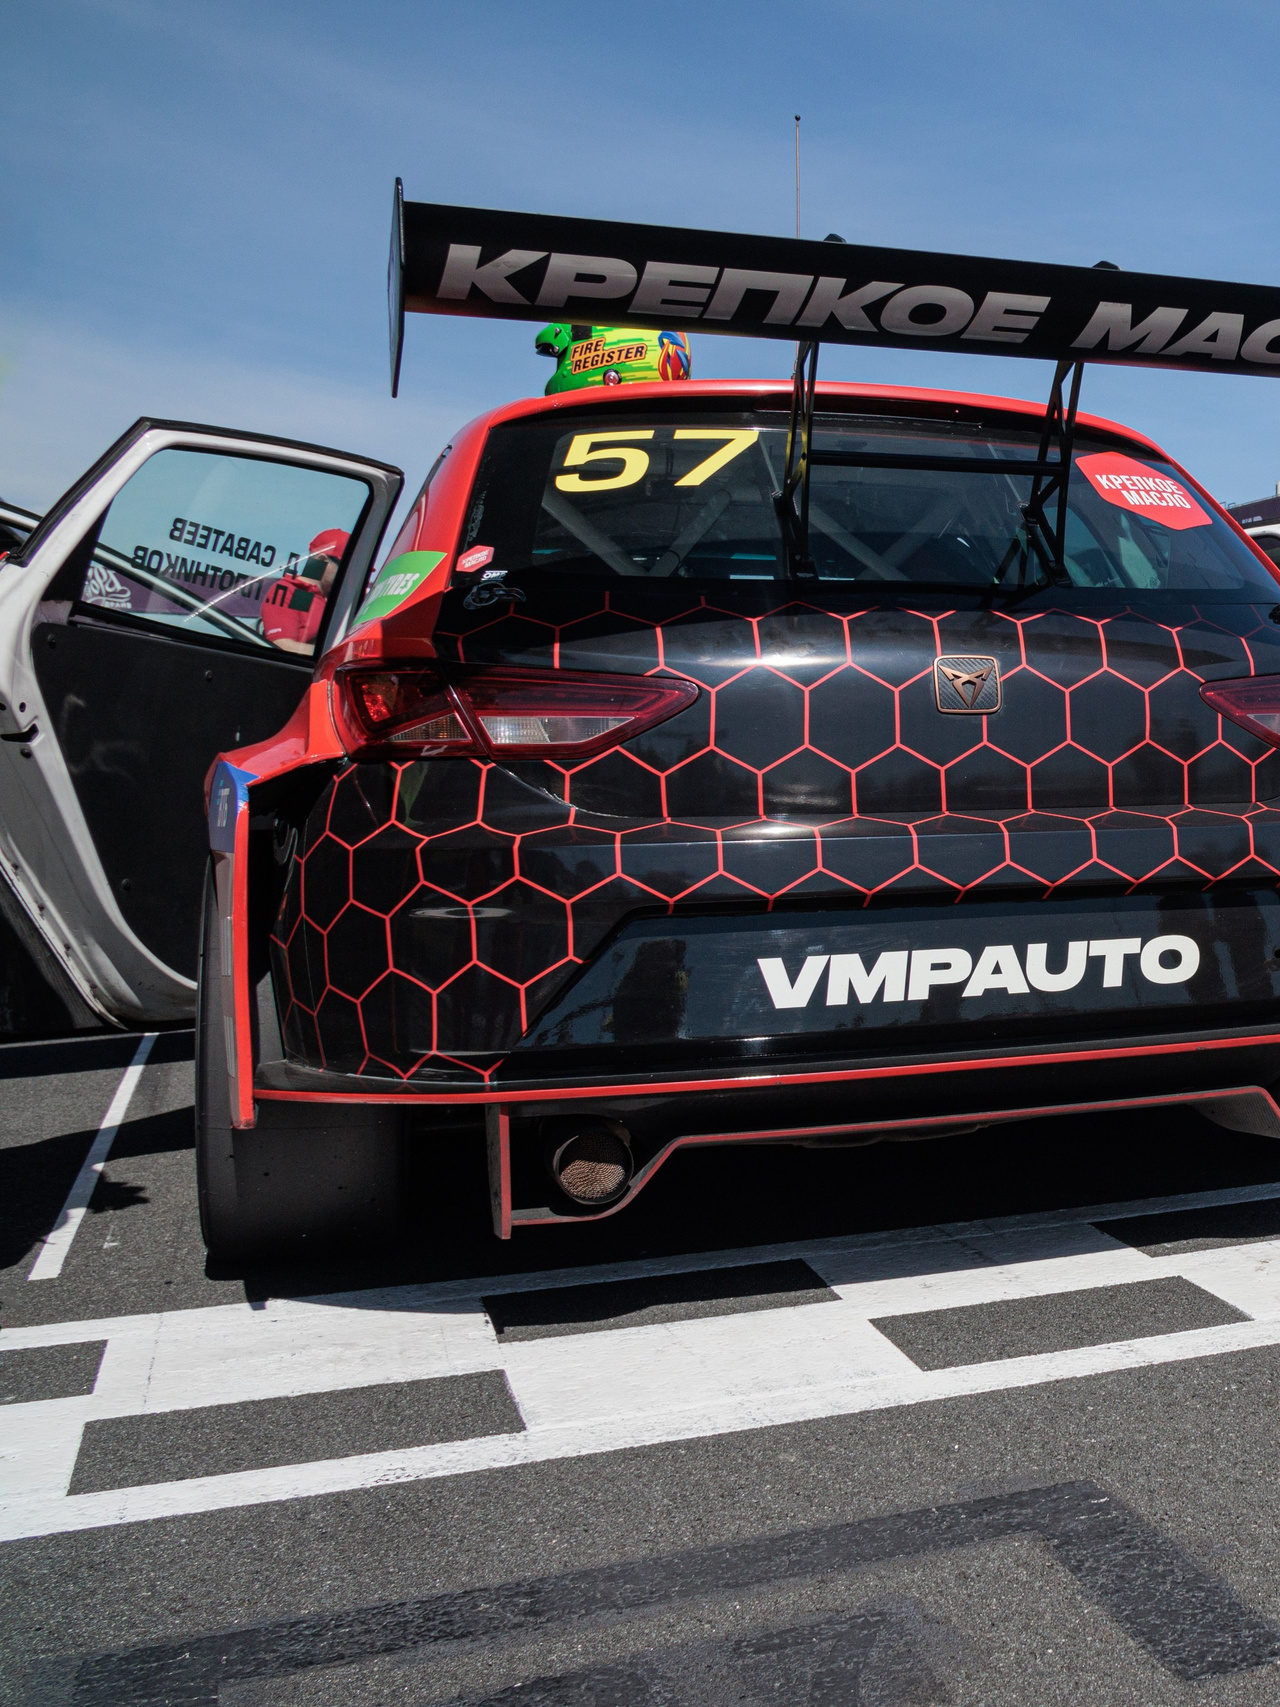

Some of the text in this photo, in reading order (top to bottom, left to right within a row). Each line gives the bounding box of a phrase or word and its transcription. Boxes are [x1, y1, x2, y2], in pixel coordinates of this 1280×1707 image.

[436, 243, 1051, 343] КРЕПКОЕ
[572, 339, 604, 360] FIRE
[573, 345, 645, 373] REGISTER
[555, 430, 758, 492] 57
[1095, 473, 1183, 496] КРЕПКОЕ
[1120, 487, 1192, 510] МАСЛО
[756, 935, 1201, 1010] VMPAUTO
